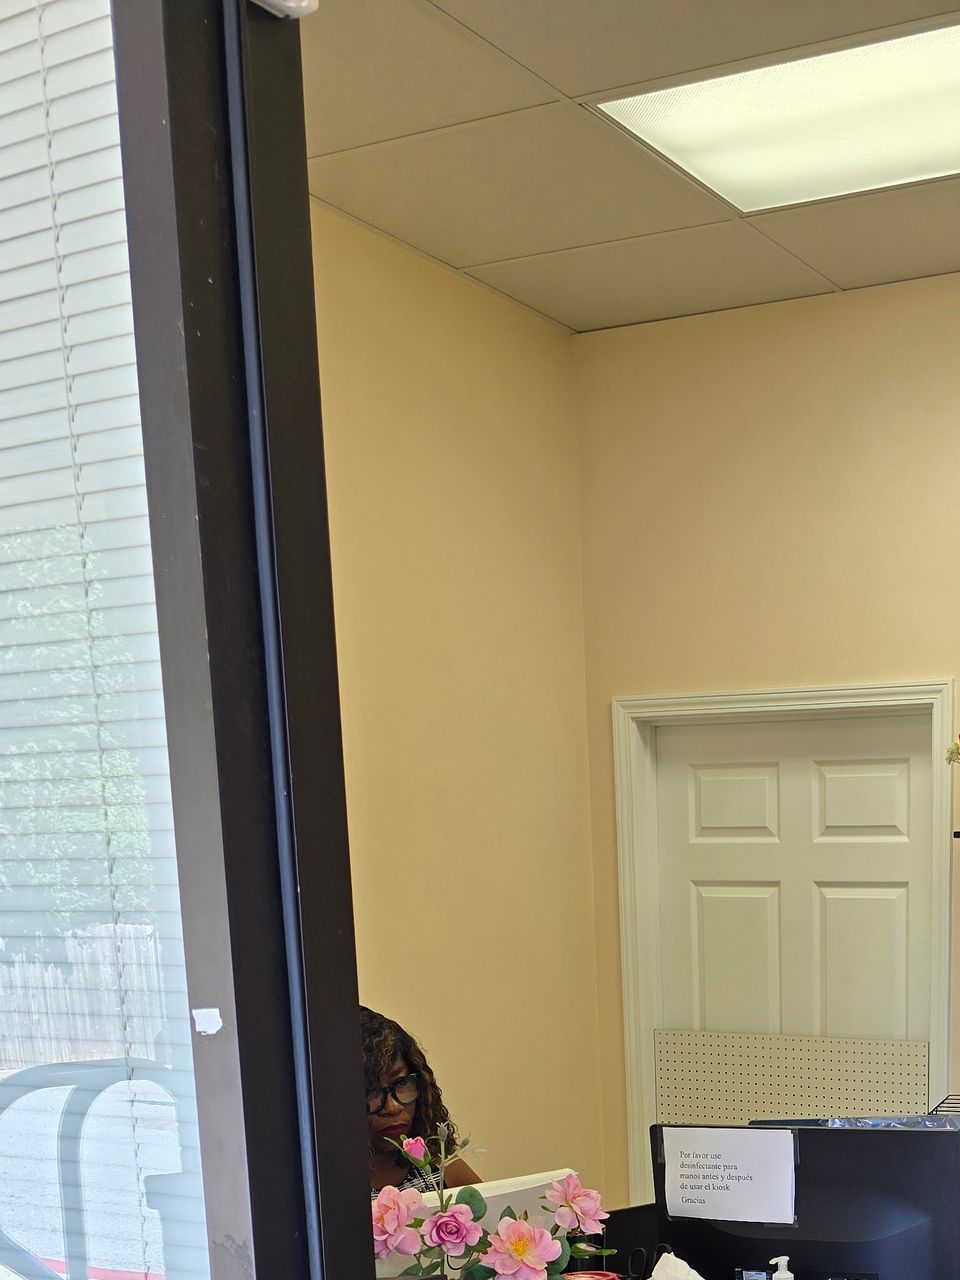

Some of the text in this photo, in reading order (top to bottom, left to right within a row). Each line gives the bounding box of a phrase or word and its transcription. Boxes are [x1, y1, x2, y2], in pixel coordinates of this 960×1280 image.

[680, 1151, 691, 1159] Por
[692, 1151, 709, 1159] favor
[680, 1161, 738, 1172] desinfectante para
[726, 1173, 753, 1182] después
[680, 1182, 688, 1190] de
[711, 1183, 731, 1191] kiosk
[681, 1196, 706, 1204] Gracias
